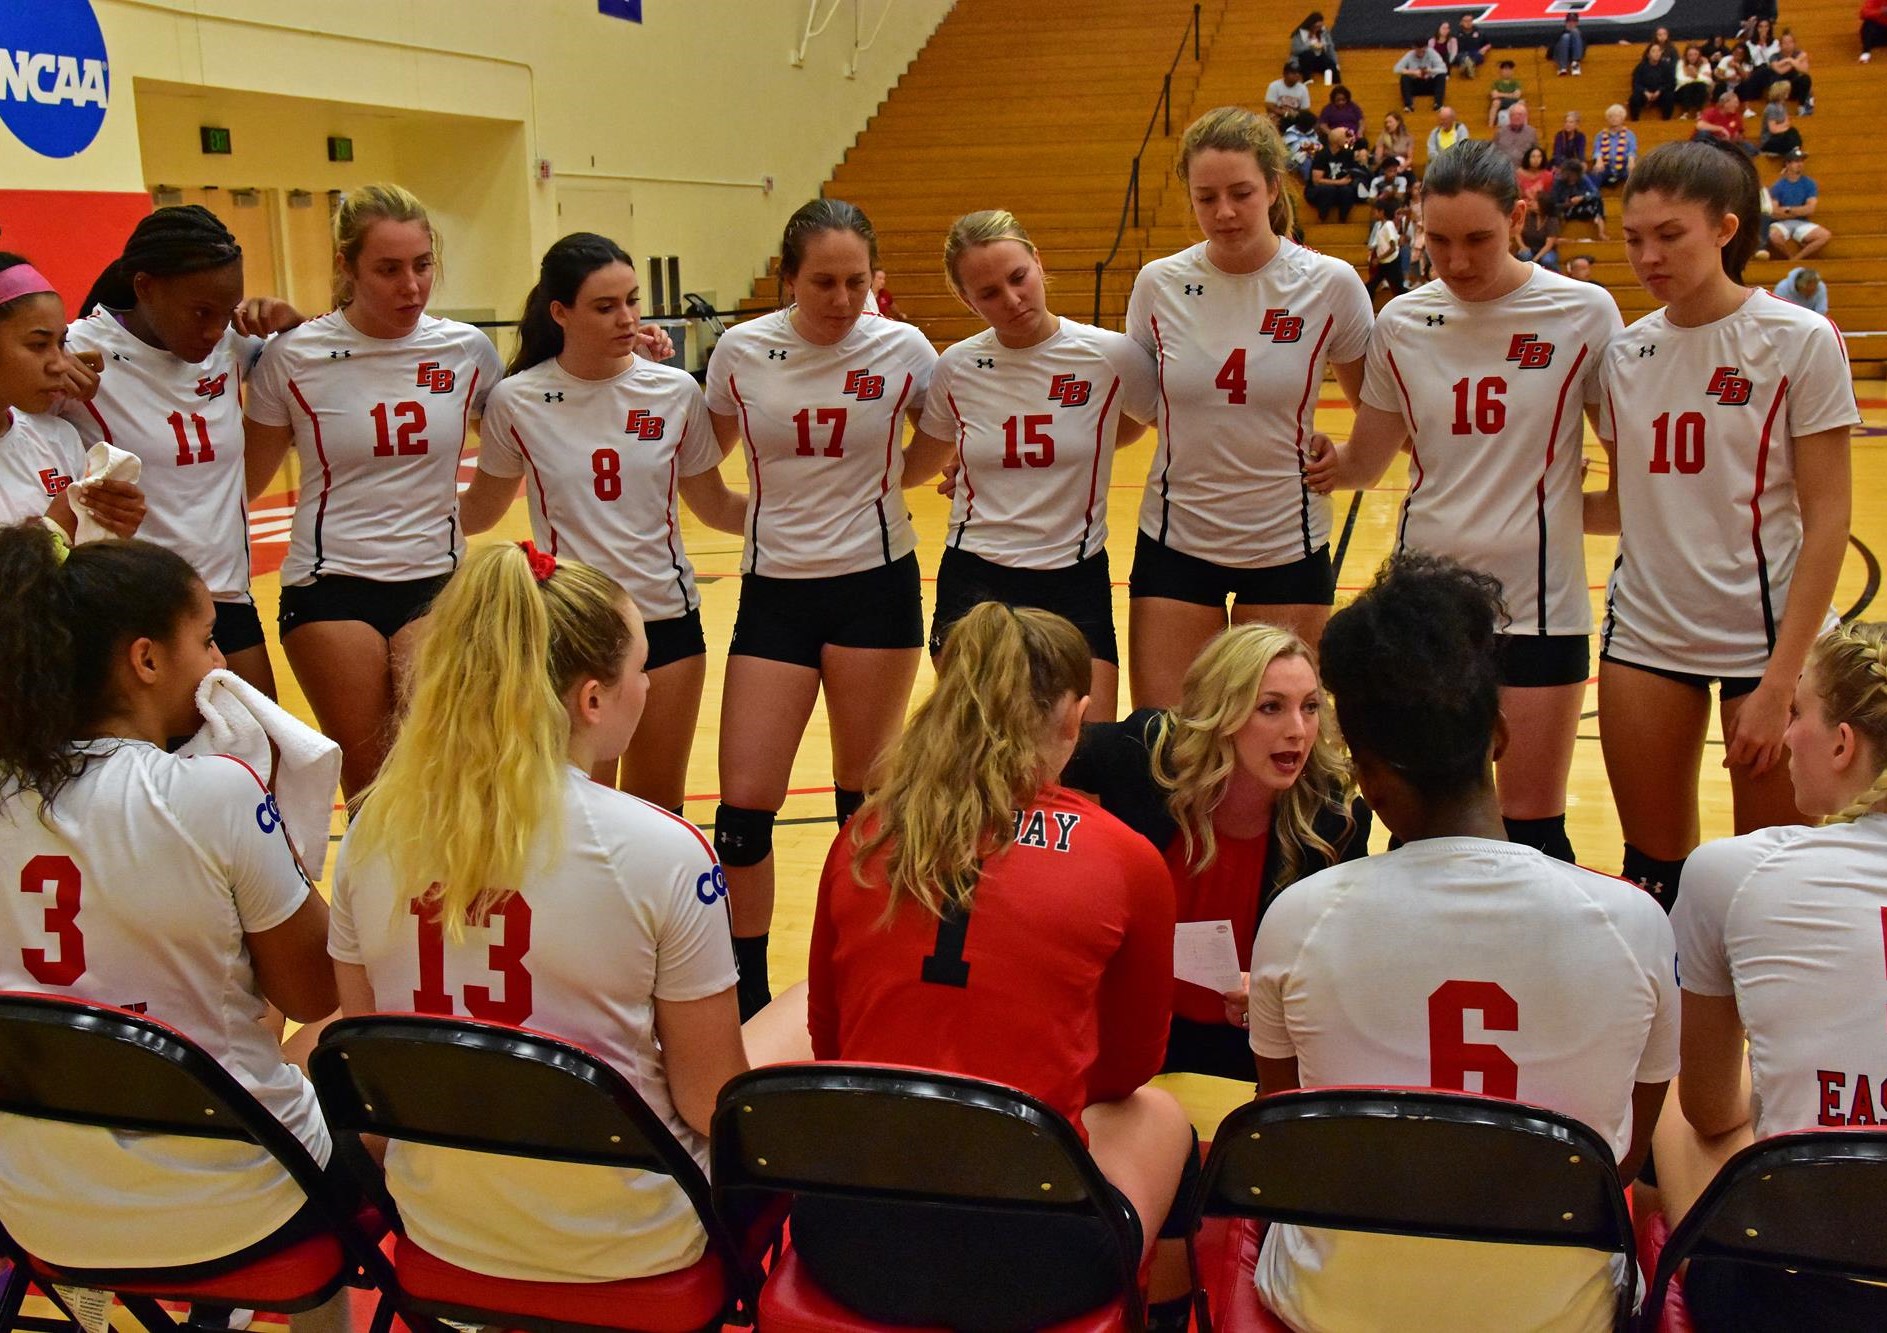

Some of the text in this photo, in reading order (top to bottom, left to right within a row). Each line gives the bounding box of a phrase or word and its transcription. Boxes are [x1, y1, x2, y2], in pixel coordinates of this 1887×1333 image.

[0, 48, 107, 109] NCAA
[1258, 308, 1304, 343] EB
[1505, 333, 1555, 369] EB
[416, 361, 455, 394] EB
[842, 368, 885, 401] EB
[1047, 372, 1092, 408] EB
[1215, 348, 1247, 405] 4
[1705, 366, 1753, 405] EB
[370, 401, 429, 457] 12
[624, 408, 665, 440] EB
[792, 408, 847, 457] 17
[1452, 376, 1507, 435] 16
[167, 410, 215, 466] 11
[1002, 414, 1055, 468] 15
[1649, 411, 1706, 474] 10
[592, 448, 621, 501] 8
[20, 855, 86, 986] 3
[922, 858, 984, 989] 1
[410, 881, 532, 1026] 13
[1428, 979, 1519, 1100] 6
[1816, 1069, 1887, 1127] EA
